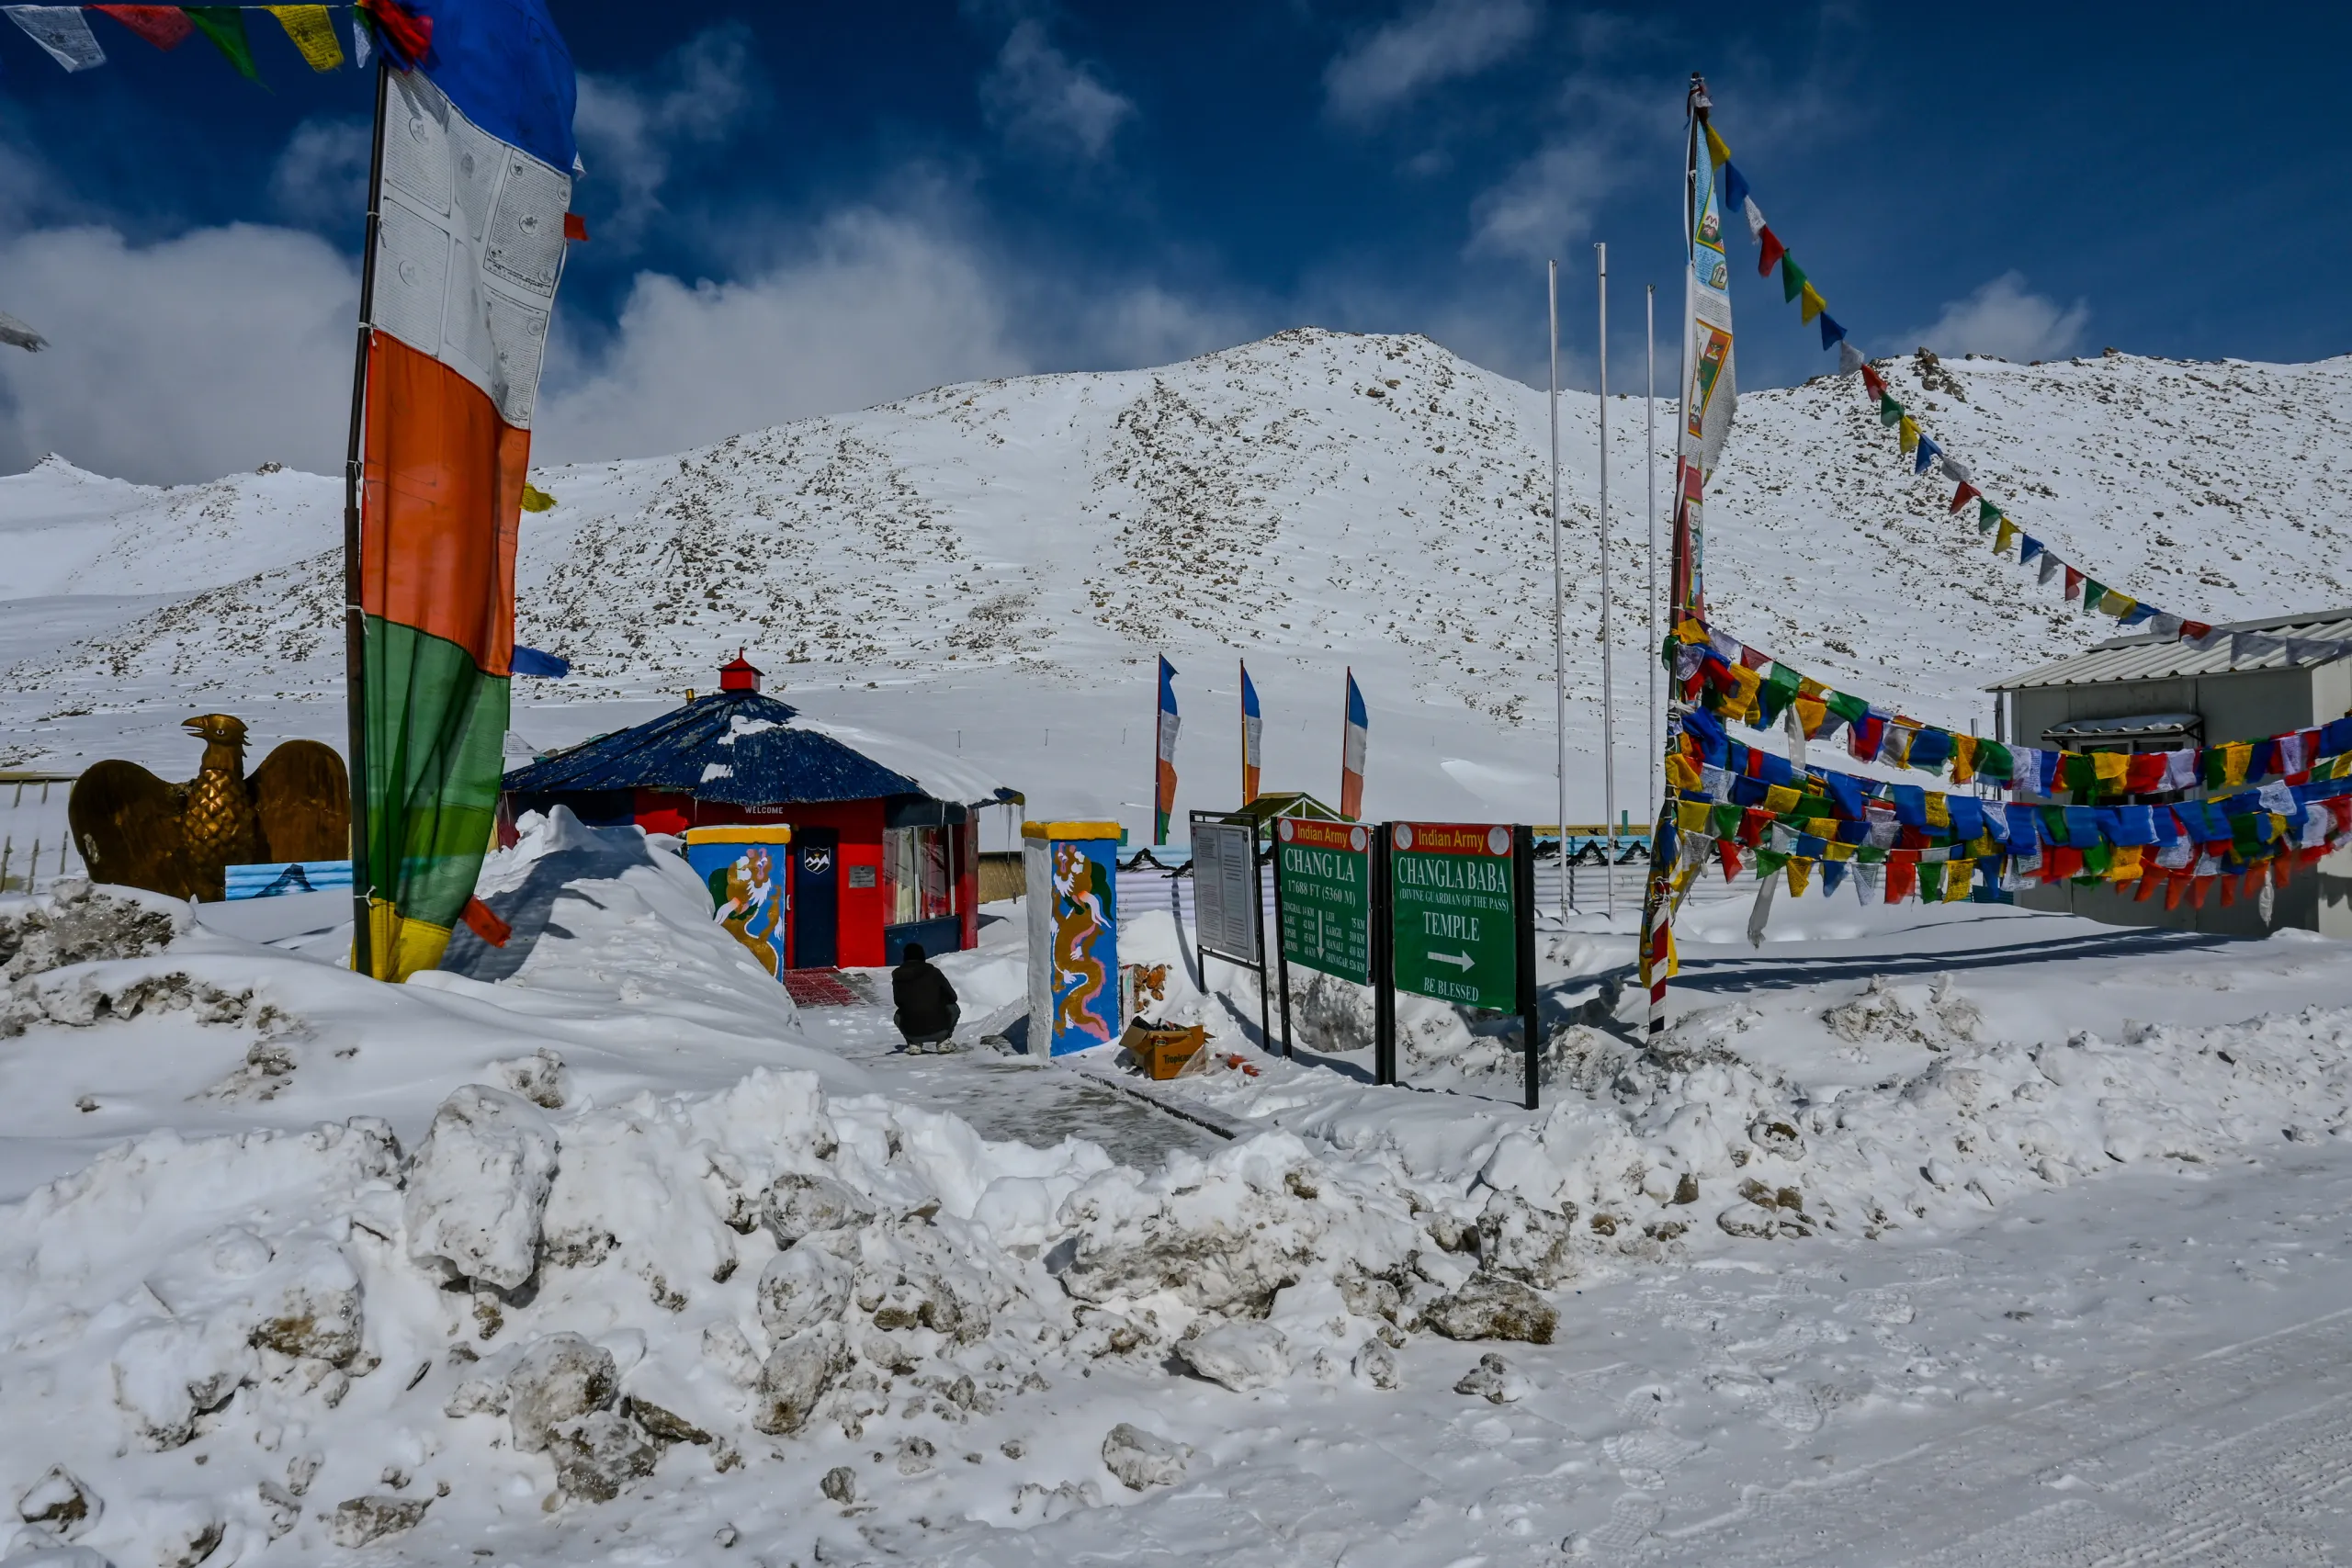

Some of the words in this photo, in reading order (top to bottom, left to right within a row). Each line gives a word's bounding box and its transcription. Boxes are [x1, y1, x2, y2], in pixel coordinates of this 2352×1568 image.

[1297, 824, 1323, 841] Indian
[1325, 827, 1348, 848] Army
[1419, 829, 1451, 847] Indian
[1453, 830, 1484, 852] Army
[1284, 848, 1332, 878] CHANG
[1336, 855, 1355, 883] LA
[1398, 856, 1464, 889] CHANGLA
[1466, 862, 1508, 894] BABA
[1288, 879, 1308, 896] 17688
[1310, 884, 1321, 898] FT
[1321, 886, 1342, 903] (5360
[1344, 891, 1356, 908] M)
[1399, 887, 1424, 902] (DIVINE
[1425, 891, 1461, 906] GUARDIAN
[1461, 895, 1473, 908] OF
[1473, 895, 1487, 908] THE
[1488, 897, 1509, 915] PASS)
[1306, 907, 1315, 918] KM
[1325, 911, 1335, 922] LEH
[1356, 919, 1365, 931] KM
[1307, 920, 1316, 931] KM
[1325, 924, 1343, 939] KARGIL
[1356, 933, 1365, 945] KM
[1423, 911, 1480, 942] TEMPLE
[1308, 933, 1316, 944] KM
[1325, 939, 1343, 953] MANALI
[1356, 947, 1365, 959] KM
[1308, 947, 1316, 958] KM
[1325, 952, 1349, 969] SRINAGAR
[1356, 961, 1365, 974] KM
[1424, 976, 1436, 993] BE
[1438, 979, 1479, 1002] BLESSED
